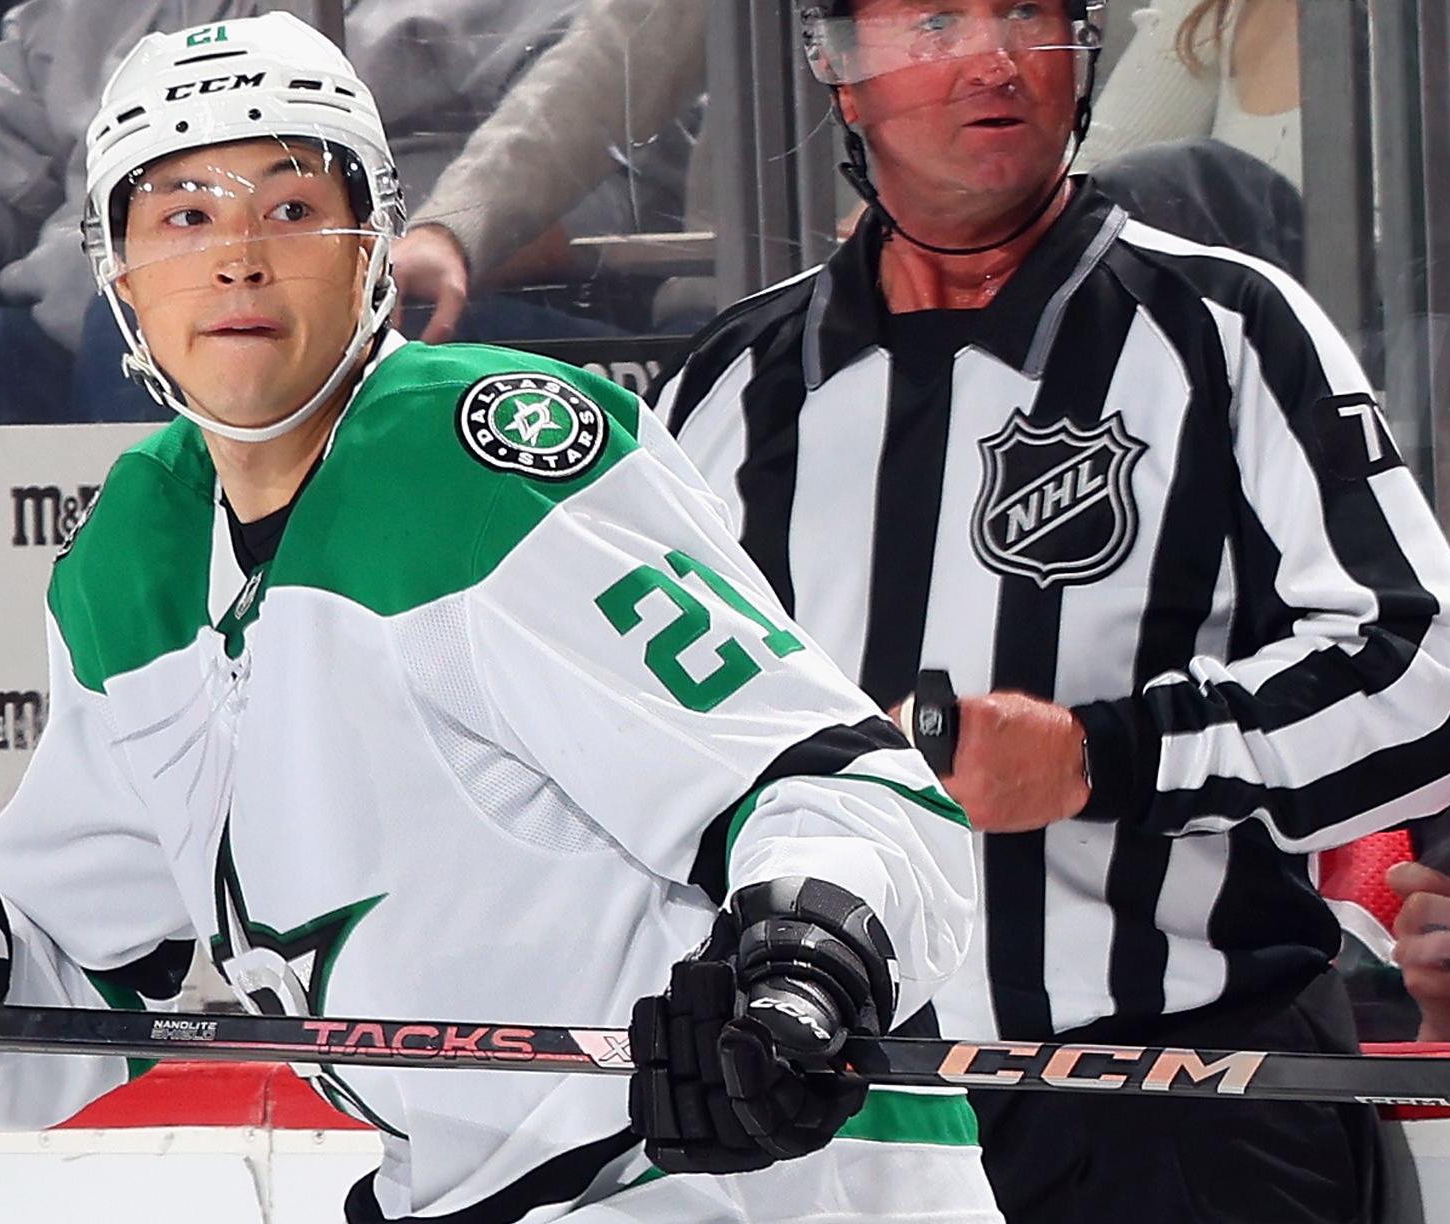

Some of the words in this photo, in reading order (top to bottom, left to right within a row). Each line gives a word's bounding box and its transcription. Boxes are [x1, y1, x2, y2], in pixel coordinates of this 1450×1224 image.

[165, 72, 267, 101] CCM
[471, 378, 561, 447] DALLAS
[518, 410, 594, 469] STARS
[1005, 459, 1106, 544] NHL
[594, 550, 805, 713] 21
[154, 1020, 218, 1030] NANOLITE
[303, 1020, 536, 1063] TACKS
[750, 997, 831, 1039] CCM
[938, 1042, 1268, 1094] CCM
